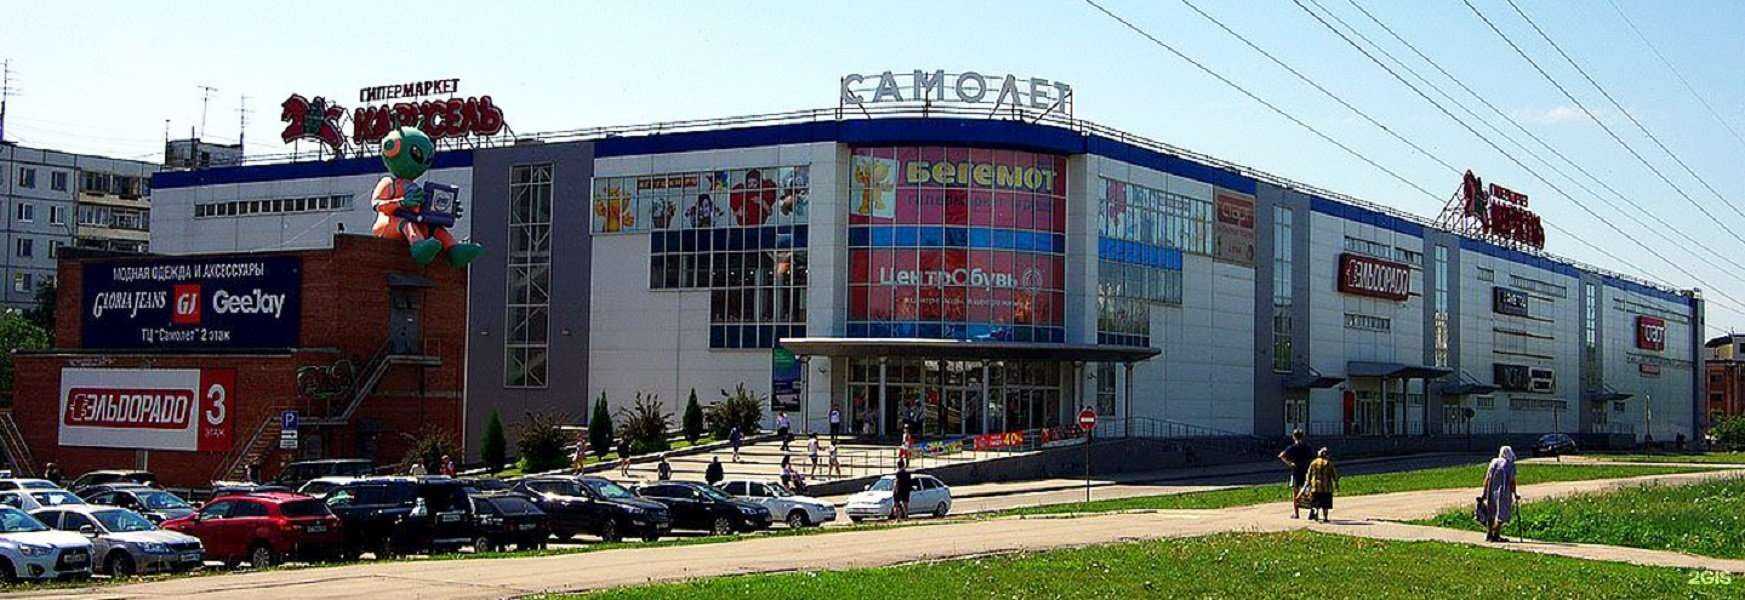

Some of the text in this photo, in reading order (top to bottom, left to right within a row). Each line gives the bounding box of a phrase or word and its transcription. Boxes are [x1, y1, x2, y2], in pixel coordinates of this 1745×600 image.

[359, 78, 460, 102] ГИПЕРМАРКЕТ
[842, 69, 1070, 113] САМОЛЕТ
[113, 262, 264, 282] МОДНАЯ ОДЕЖДА И АКСЕССУАРЫ
[130, 291, 167, 318] JEANS
[212, 288, 285, 318] GeeJay
[200, 329, 207, 341] 2
[206, 383, 226, 425] 3
